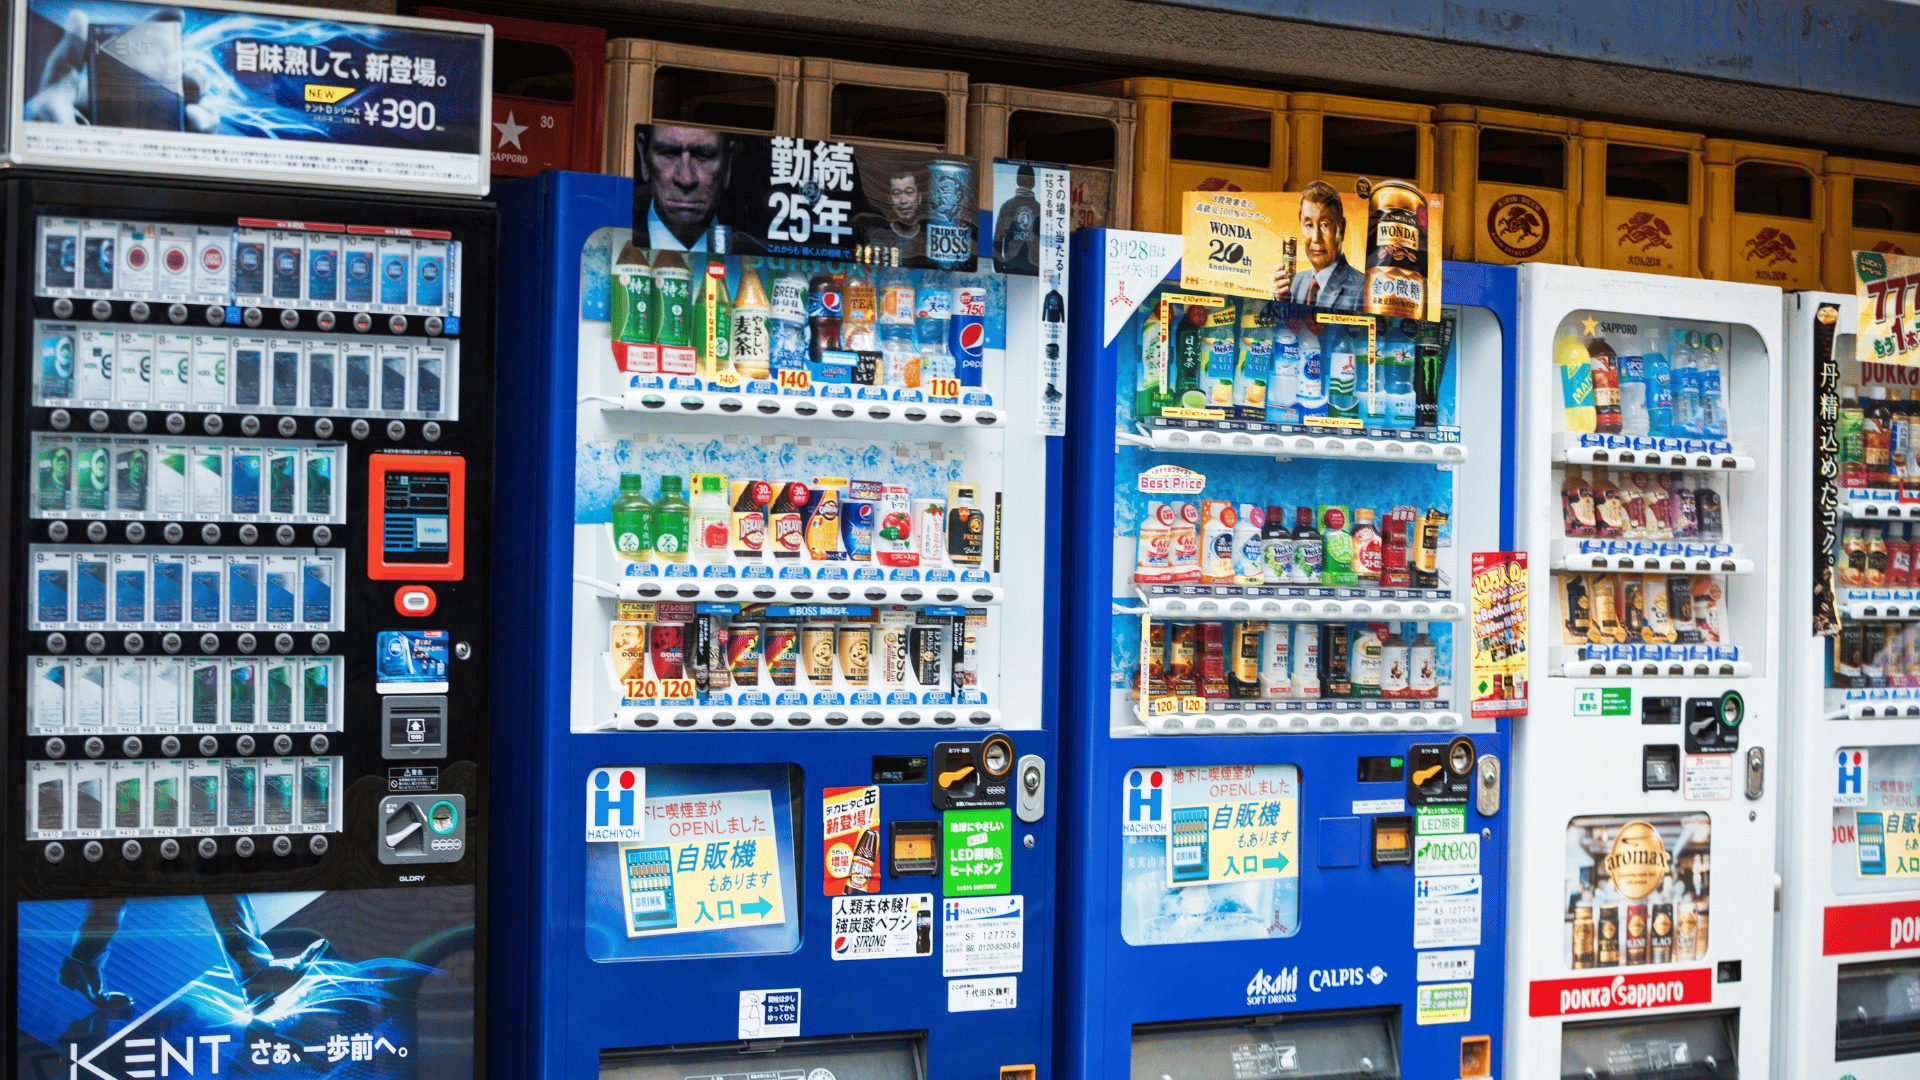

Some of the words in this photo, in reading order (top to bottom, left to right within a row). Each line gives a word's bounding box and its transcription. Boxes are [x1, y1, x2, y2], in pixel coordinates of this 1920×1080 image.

[235, 41, 447, 87] 旨味熟して、新登場。
[308, 88, 336, 99] NEW
[364, 98, 436, 131] ¥390
[540, 115, 555, 129] 30
[491, 152, 528, 164] SAPPORO
[770, 136, 854, 192] 勤続
[767, 191, 853, 244] 25年
[1209, 221, 1252, 240] WONDA
[1380, 226, 1416, 242] WONDA
[930, 236, 969, 255] BOSS
[1109, 238, 1166, 260] 3月28日は
[1208, 239, 1252, 267] 20th
[1109, 261, 1159, 278] 三ツ矢の日
[1208, 263, 1252, 276] Anniversary
[773, 285, 800, 298] GREEN
[1373, 277, 1421, 300] 金の微糖
[851, 299, 874, 309] TEA
[734, 315, 752, 357] 麦茶
[752, 315, 764, 356] やさしい
[1601, 321, 1638, 335] SAPPORO
[1140, 476, 1169, 489] Best
[1172, 476, 1202, 490] Price
[891, 501, 909, 509] トマト
[1474, 561, 1521, 595] 10万人の
[795, 606, 818, 616] BOSS
[926, 630, 934, 651] BOSS
[896, 632, 906, 682] BOSS
[1173, 764, 1256, 784] 地下に喫煙室が
[1209, 778, 1290, 798] OPENしました
[825, 807, 874, 836] 新登場!
[1212, 800, 1281, 831] 自販機
[588, 828, 641, 840] HACHIYOH
[669, 815, 767, 837] OPENしました
[950, 820, 1005, 833] 地球にやさしい
[1123, 823, 1167, 833] HACHIYOH
[1237, 829, 1292, 849] もあります
[676, 839, 757, 874] 自販機
[830, 856, 850, 868] 増量
[1176, 850, 1198, 861] DRINK
[1607, 849, 1670, 871] aromax
[950, 861, 1004, 877] ヒートポンプ
[1223, 855, 1258, 877] 入口
[708, 870, 773, 893] もあります
[973, 883, 998, 891] SUNTORY
[635, 896, 662, 908] DRINK
[835, 897, 910, 916] 人類未体験!
[960, 906, 997, 915] HACHIYOH
[1434, 907, 1444, 915] AS
[1449, 905, 1476, 915] 127774
[694, 900, 735, 925] 入口
[835, 917, 913, 935] 強炭酸ペプシ
[965, 932, 976, 941] SF
[983, 929, 1017, 940] 127775
[854, 934, 887, 949] STRONG
[1246, 965, 1298, 996] Asahi
[1309, 967, 1364, 992] CALPIS
[1246, 995, 1267, 1006] SOFT
[1268, 993, 1297, 1004] DRINKS
[1560, 985, 1611, 1014] pokka
[1611, 975, 1684, 1008] sapporo
[767, 1013, 795, 1022] ゆっくりと
[768, 1004, 796, 1013] まってから
[70, 1034, 231, 1080] KENT
